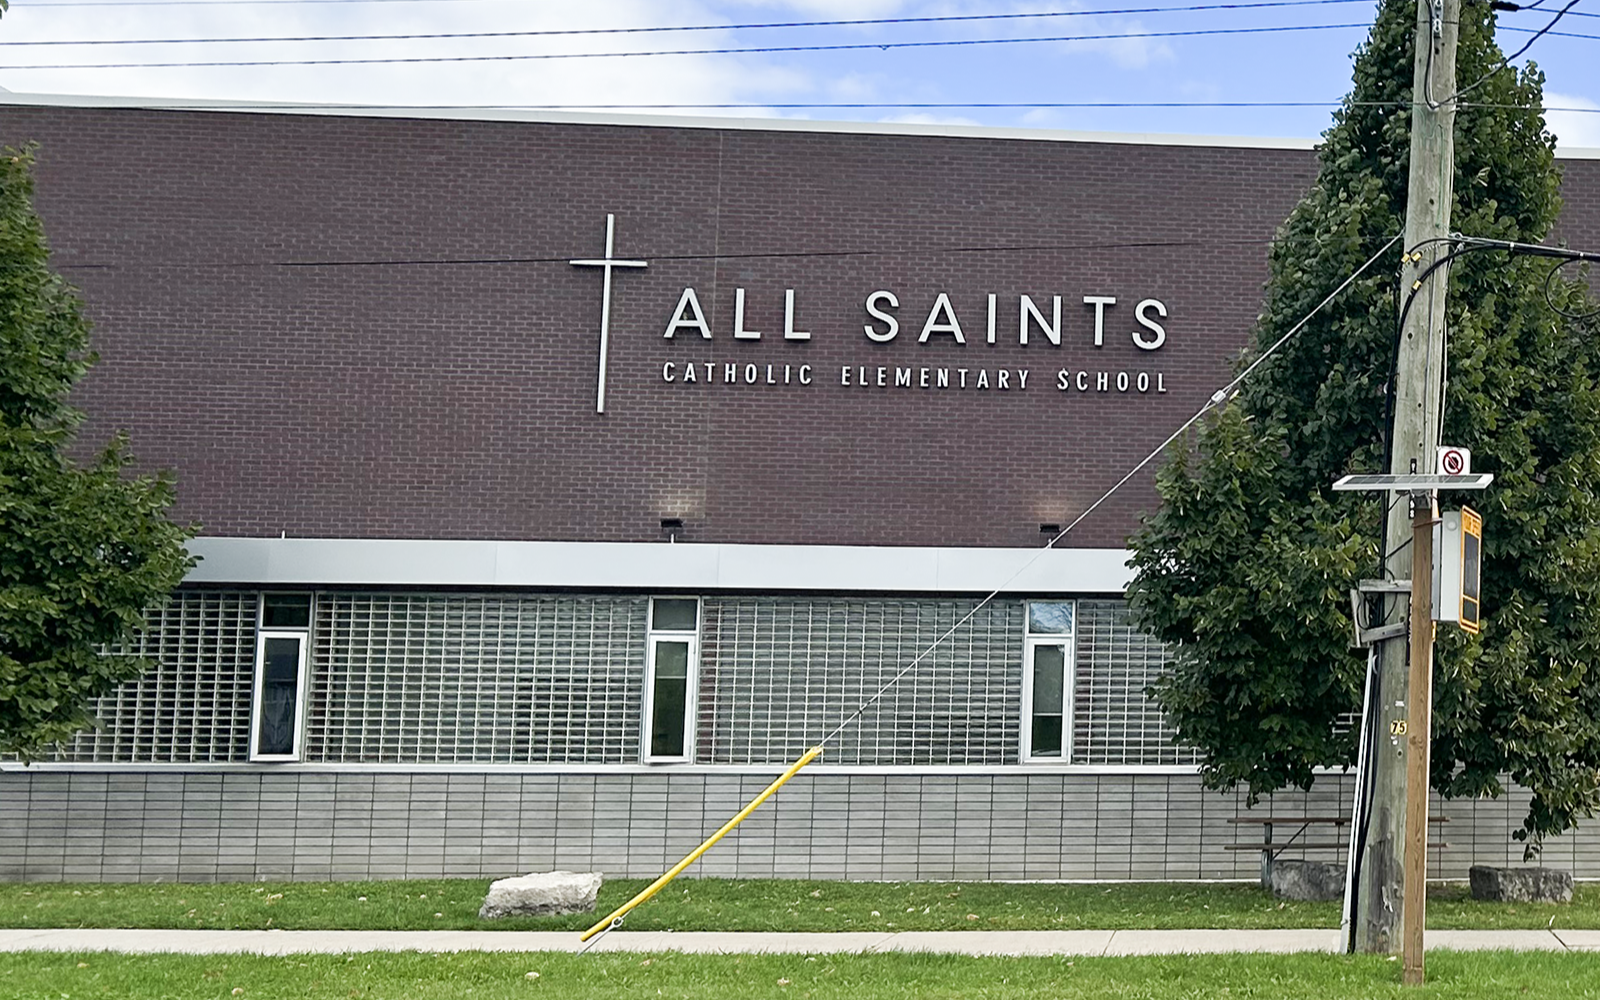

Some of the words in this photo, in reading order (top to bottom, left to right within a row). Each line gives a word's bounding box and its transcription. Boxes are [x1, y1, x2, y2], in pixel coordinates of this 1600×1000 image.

[663, 287, 812, 341] ALL
[863, 290, 1169, 351] SAINTS
[663, 361, 813, 385] CATHOLIC
[841, 365, 1030, 390] ELEMENTARY
[1057, 368, 1168, 393] SCHOOL
[1392, 721, 1406, 734] 75
